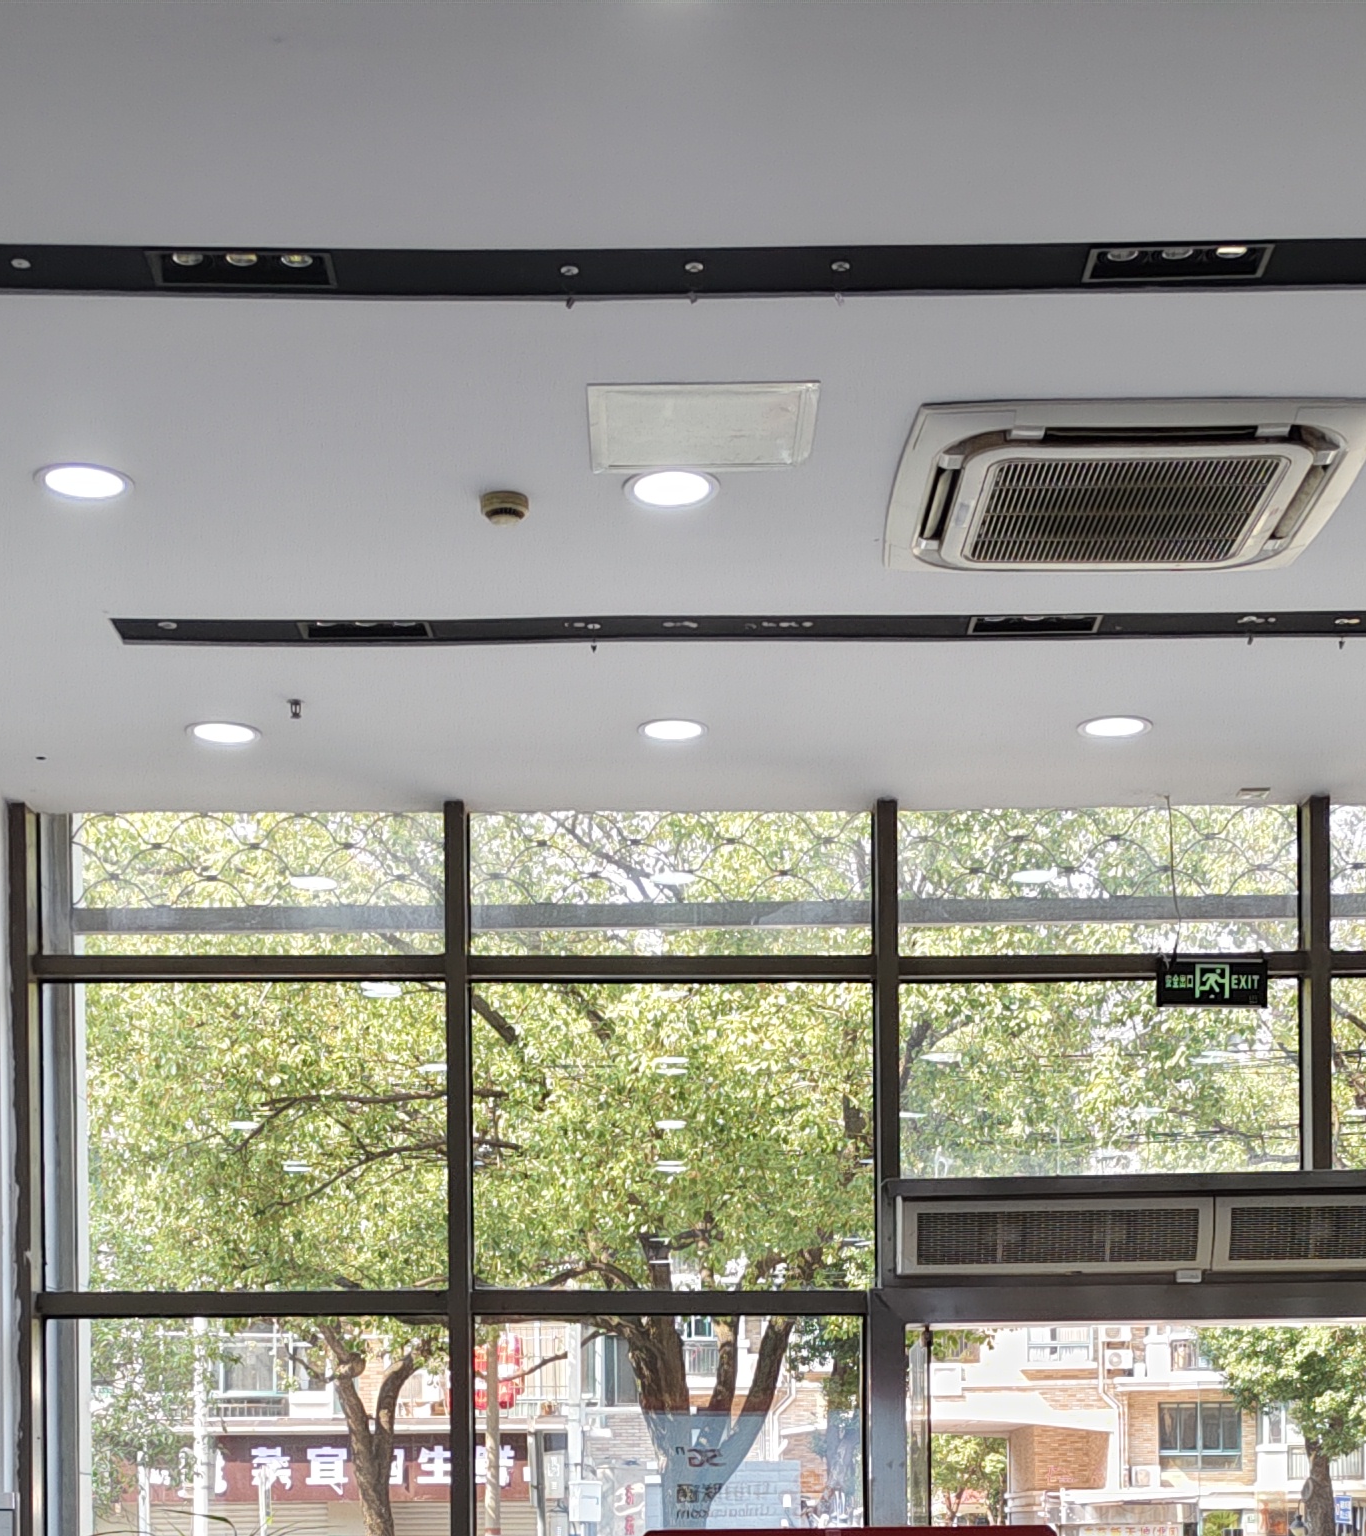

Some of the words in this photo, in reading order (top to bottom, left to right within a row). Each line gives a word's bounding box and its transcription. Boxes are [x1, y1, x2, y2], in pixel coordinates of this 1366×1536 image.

[1165, 975, 1194, 989] 安全出口
[1230, 974, 1260, 990] EXIT
